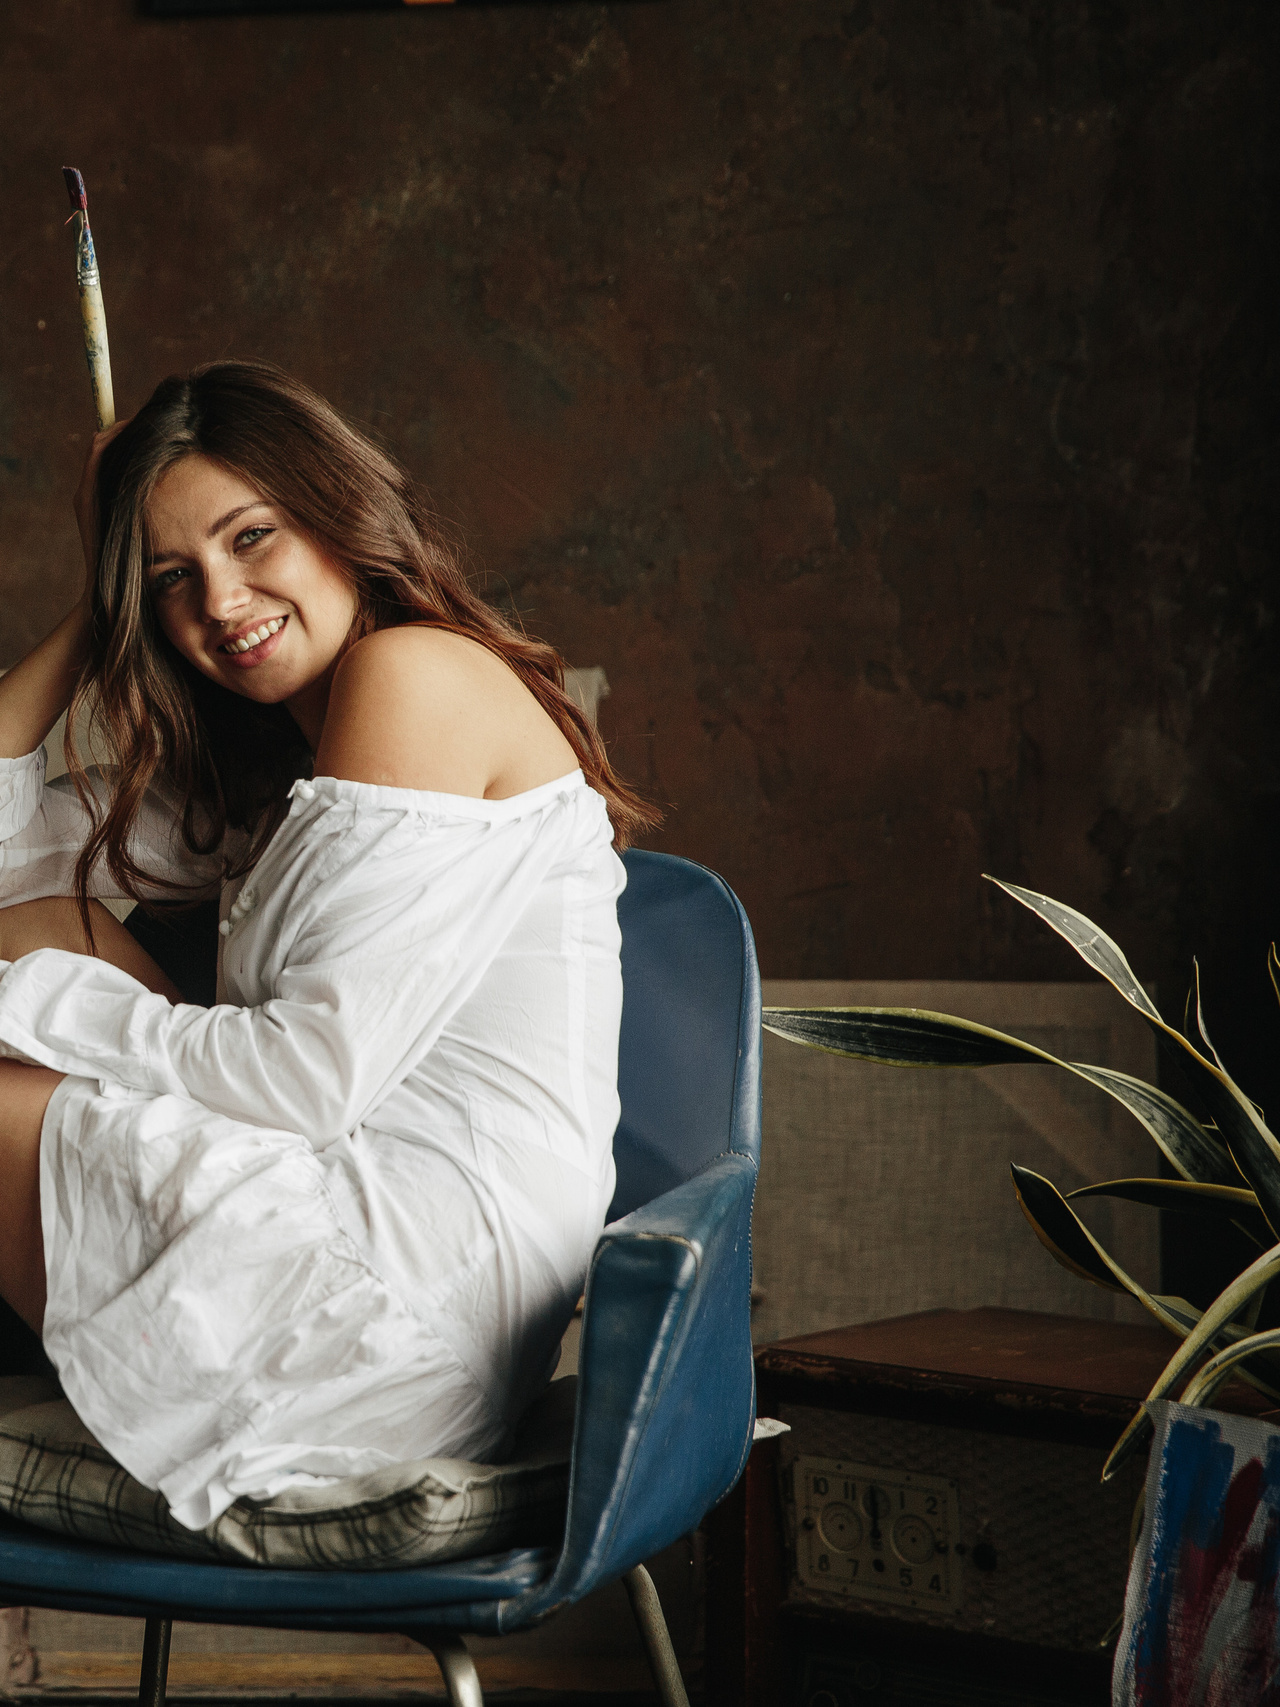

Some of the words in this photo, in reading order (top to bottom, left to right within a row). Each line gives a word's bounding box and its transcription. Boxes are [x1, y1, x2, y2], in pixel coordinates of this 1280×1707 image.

[813, 1476, 829, 1496] 10
[843, 1481, 856, 1501] 11
[899, 1491, 905, 1509] 1
[925, 1496, 938, 1515] 2
[818, 1554, 830, 1572] 8
[848, 1559, 860, 1577] 7
[899, 1568, 912, 1587] 5
[928, 1574, 941, 1593] 4
